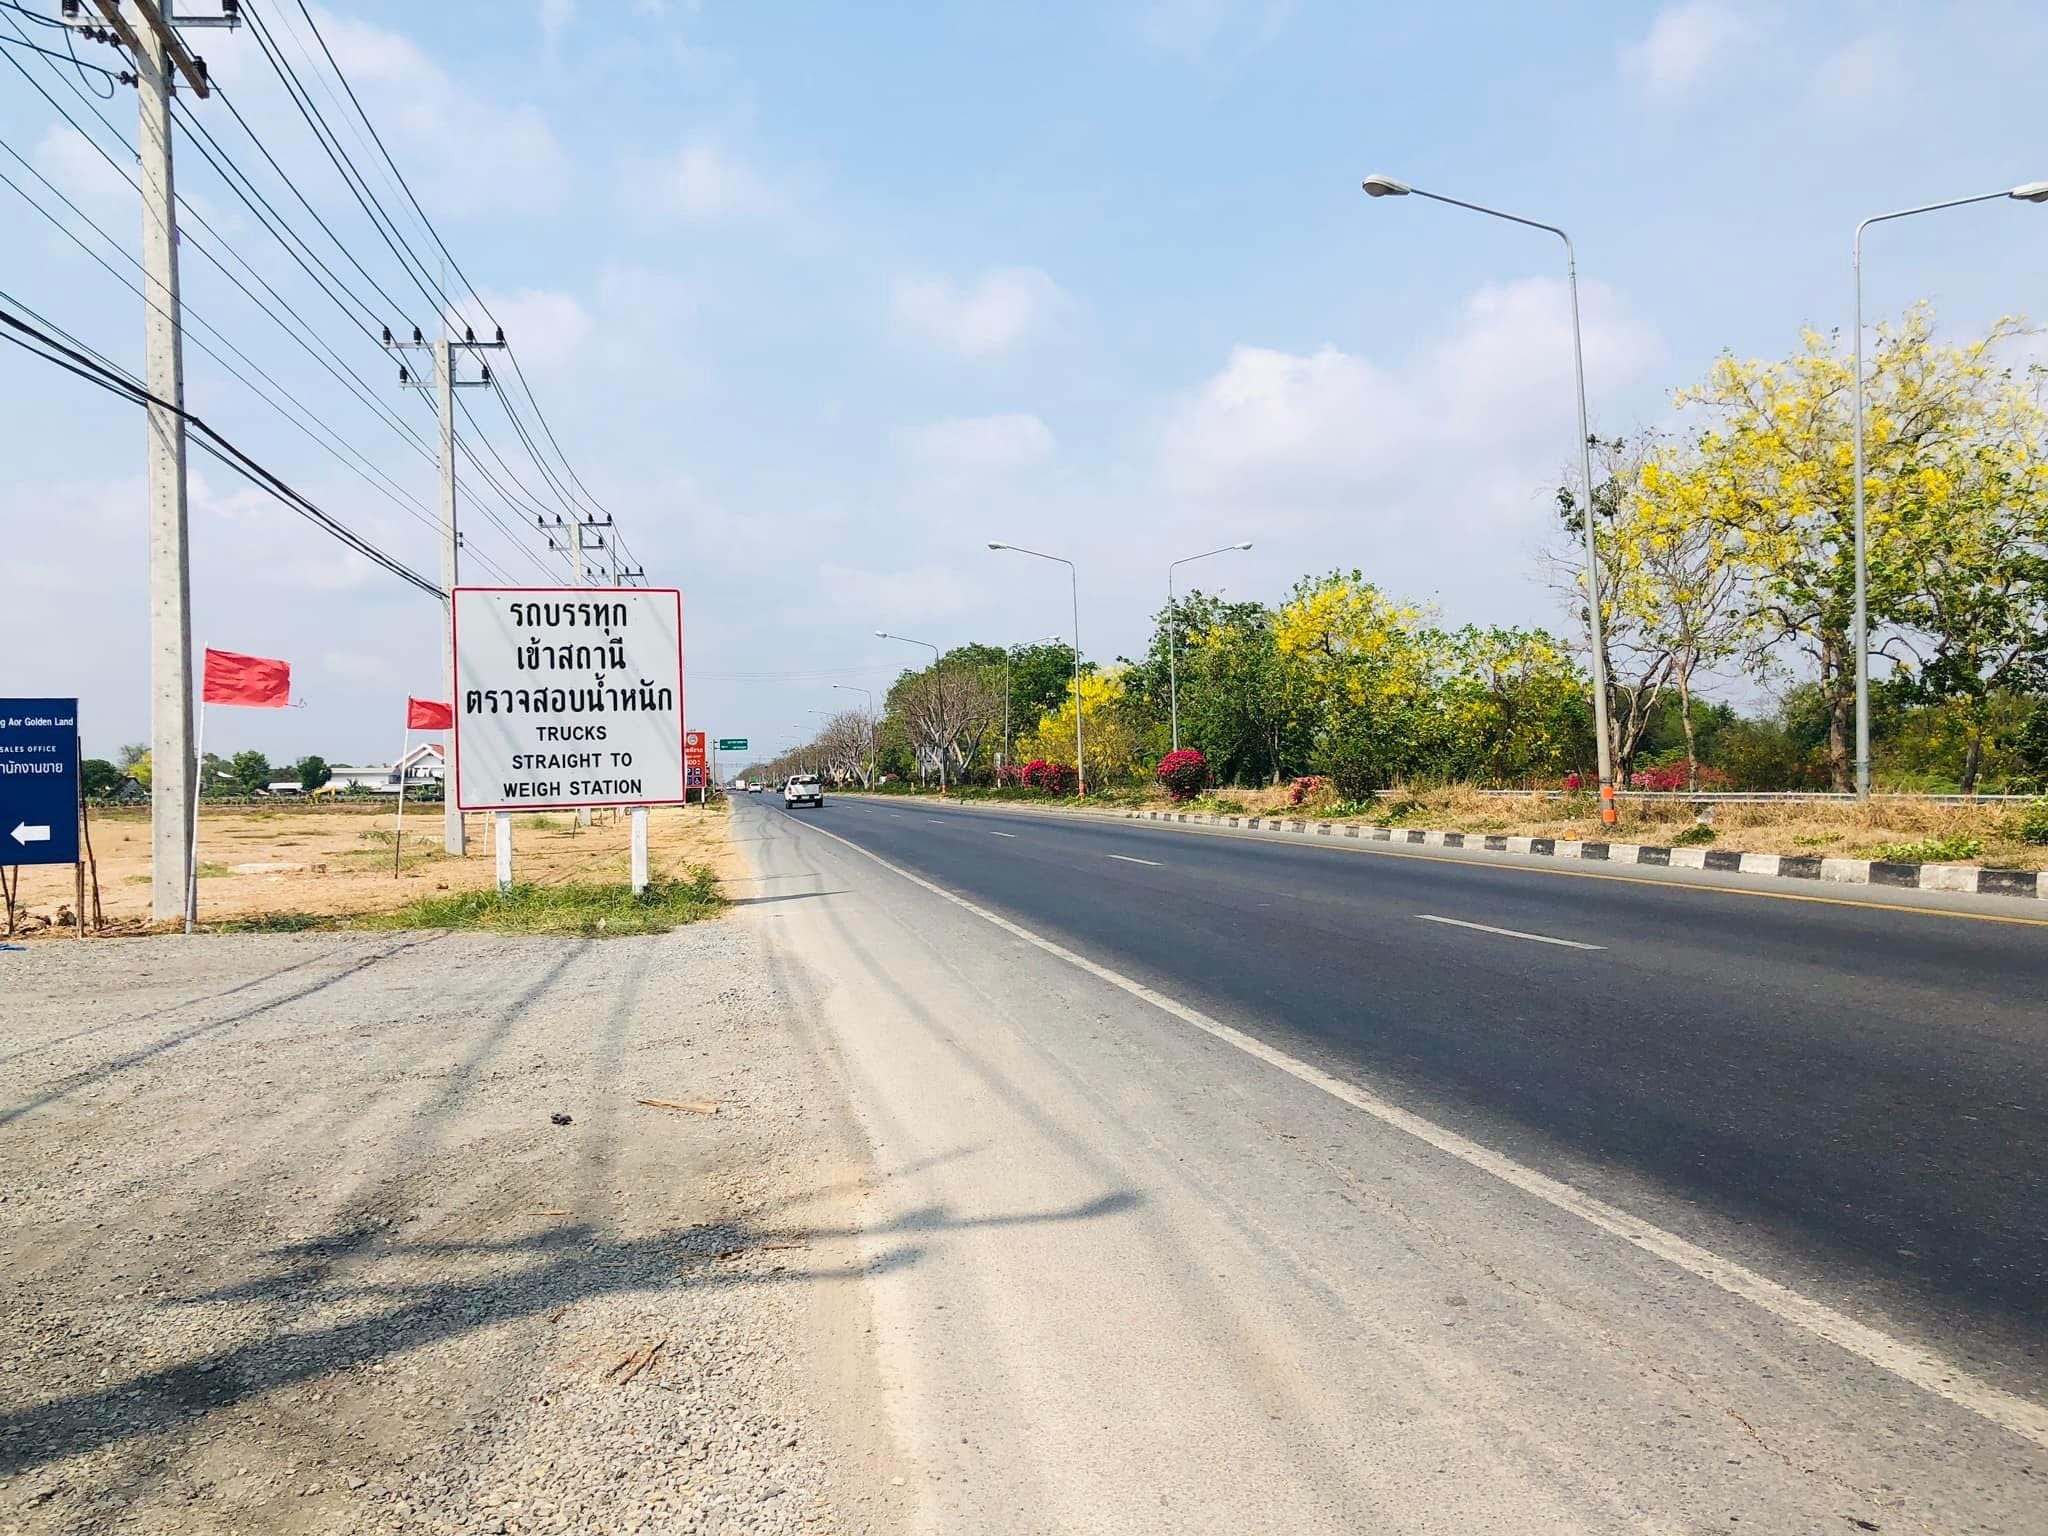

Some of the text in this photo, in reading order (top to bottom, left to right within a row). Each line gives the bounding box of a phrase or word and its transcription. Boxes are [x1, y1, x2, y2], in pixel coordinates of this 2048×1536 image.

[511, 603, 627, 635] รถบรรทุก
[517, 637, 627, 670] เข้าสถานี
[467, 673, 672, 714] ตรวจสอบน้ำหนัก
[8, 717, 22, 726] Aor
[25, 717, 52, 726] Golden
[54, 717, 74, 726] Land
[536, 726, 607, 741] TRUCKS
[27, 745, 57, 753] OFFICE
[512, 753, 633, 769] STRAIGHT TO
[504, 779, 642, 797] WEIGH STATION
